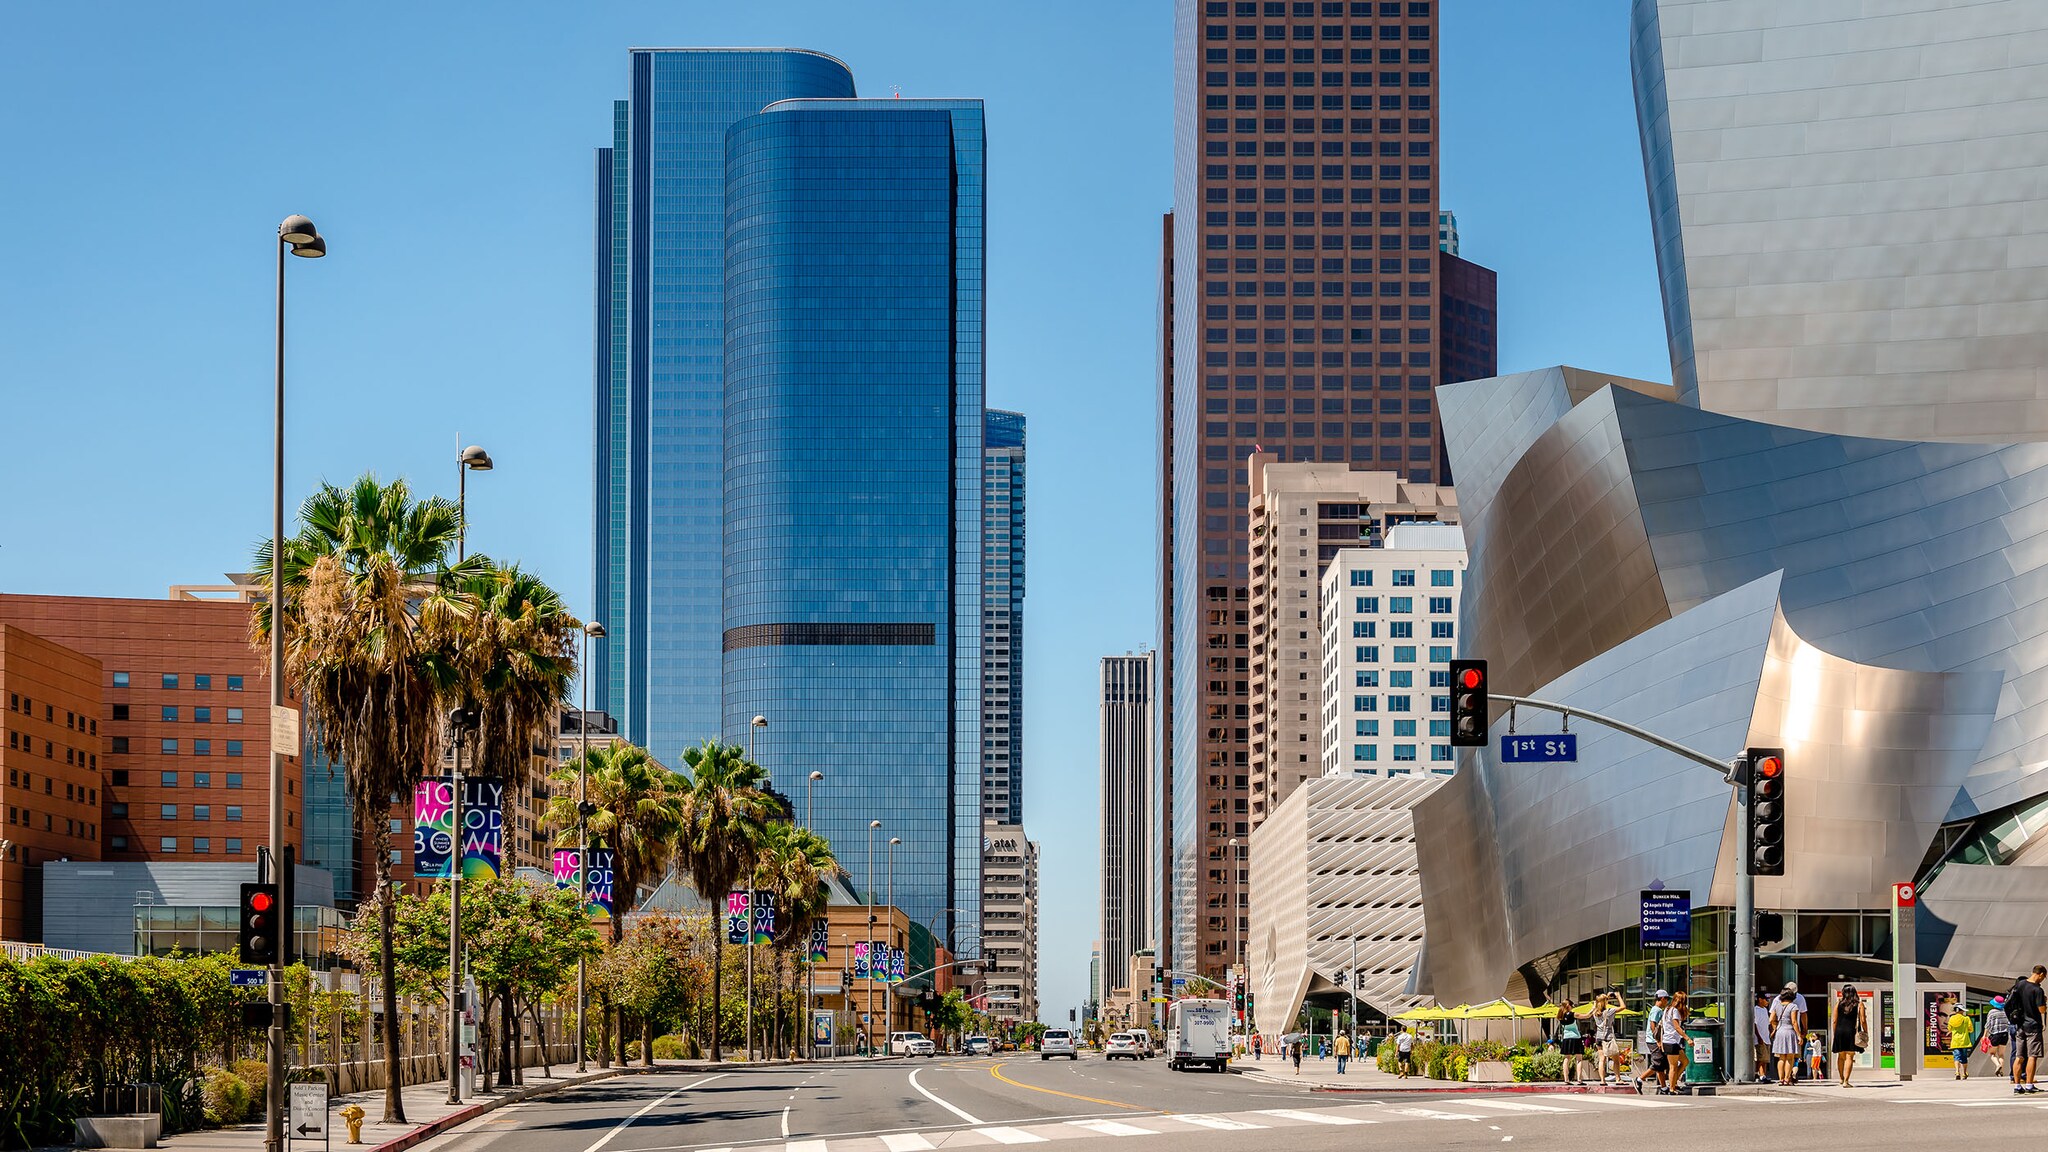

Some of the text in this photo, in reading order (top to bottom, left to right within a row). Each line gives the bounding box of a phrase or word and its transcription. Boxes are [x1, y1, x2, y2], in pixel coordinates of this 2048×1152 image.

[1512, 740, 1566, 757] 1st St
[415, 808, 502, 830] WOOD
[415, 831, 501, 856] BOWL
[554, 852, 613, 868] HOLLY
[554, 870, 613, 884] WOOD
[729, 894, 774, 906] HOLLY
[729, 908, 774, 918] WOOD
[729, 920, 774, 932] BOWL
[855, 943, 887, 952] HOLLY
[855, 960, 887, 970] BOWL
